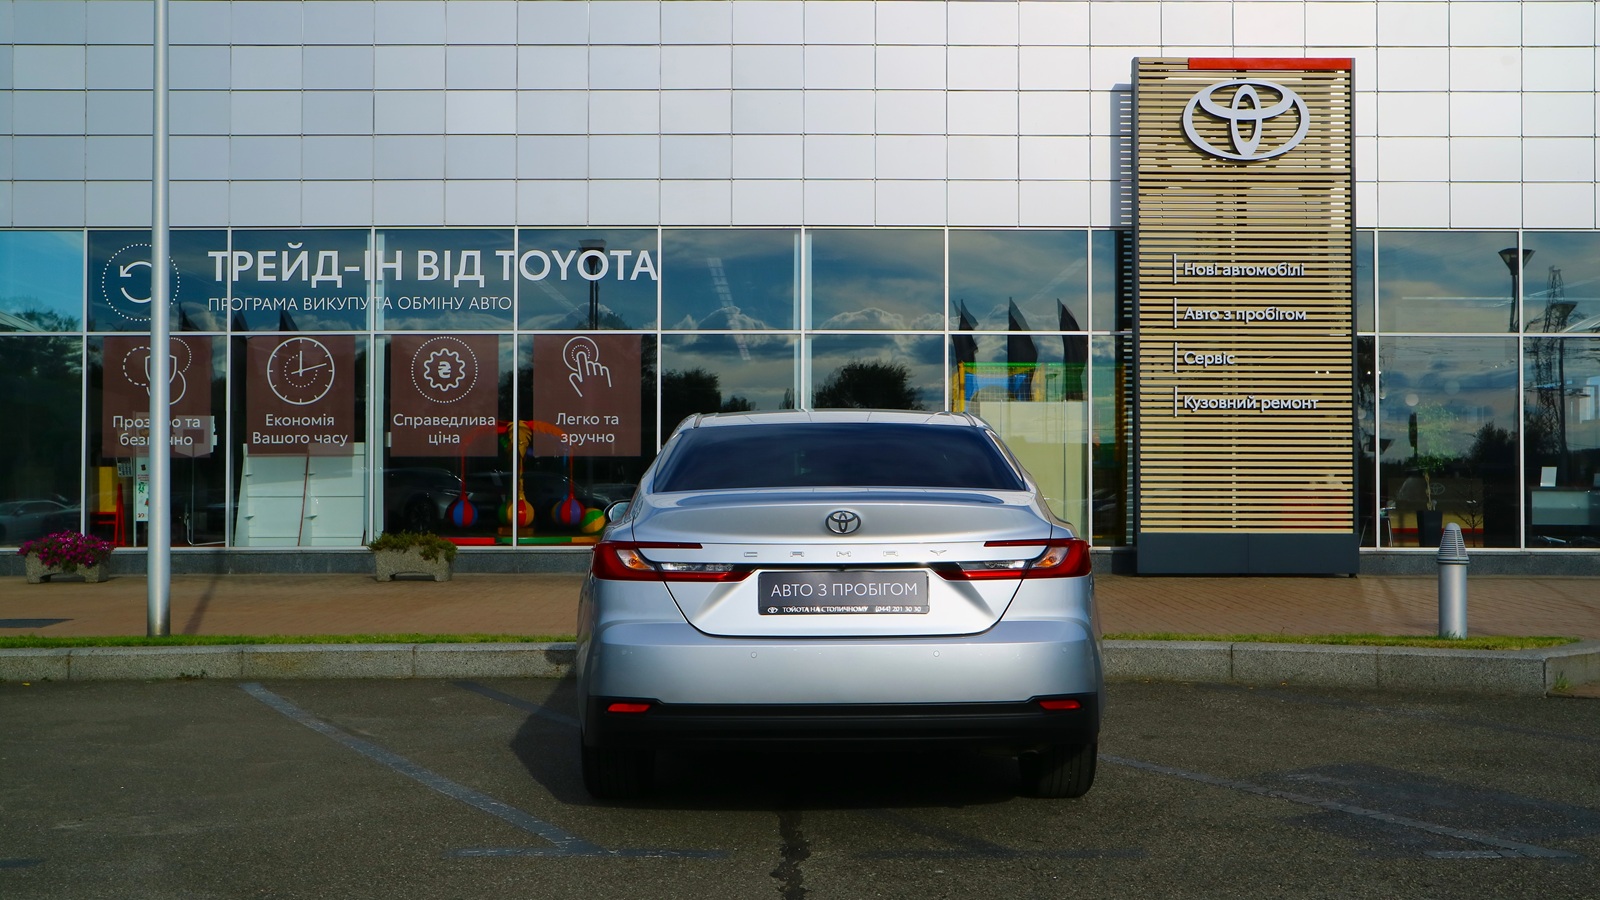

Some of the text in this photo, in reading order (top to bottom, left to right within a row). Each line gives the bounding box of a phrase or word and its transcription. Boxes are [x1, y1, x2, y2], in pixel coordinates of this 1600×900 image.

[417, 250, 485, 288] ВІД
[495, 249, 659, 281] TOYOTA
[1183, 262, 1305, 276] Нові автомобілі
[208, 296, 512, 311] ПРОГРАМА ВИКУПУ ТА ОБМІНУ АВТО
[1183, 307, 1307, 324] Авто з пробігом
[1183, 352, 1235, 367] Сервіс
[1183, 395, 1318, 412] Кузовний ремонт
[113, 415, 201, 431] Прозо та
[265, 413, 335, 426] Економія
[393, 413, 496, 427] Справедлива
[556, 412, 619, 425] Легко та
[252, 432, 348, 447] Вашого часу
[428, 431, 460, 445] ціна
[560, 433, 615, 447] зручно
[771, 584, 813, 597] АВТО
[832, 582, 918, 596] ПРОБІГОМ
